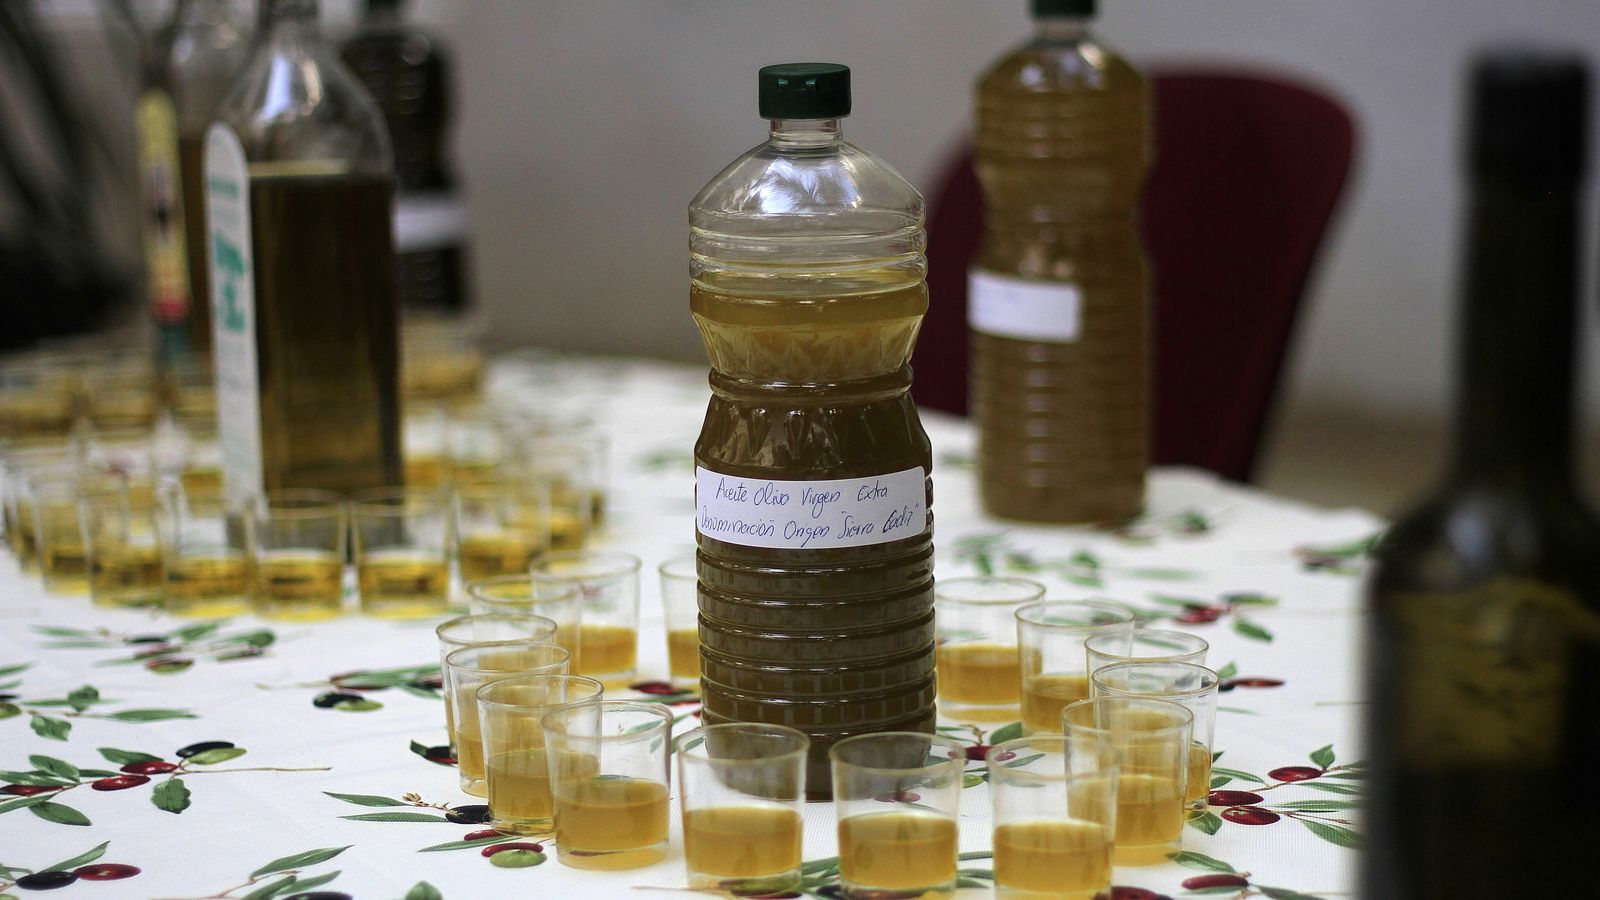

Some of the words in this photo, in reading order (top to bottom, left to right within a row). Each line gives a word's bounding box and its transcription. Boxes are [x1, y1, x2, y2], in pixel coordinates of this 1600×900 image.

[715, 477, 748, 502] Aceite
[753, 481, 790, 506] Olivo
[801, 487, 841, 518] Virgen
[856, 480, 889, 502] Extra
[783, 520, 830, 548] Origen
